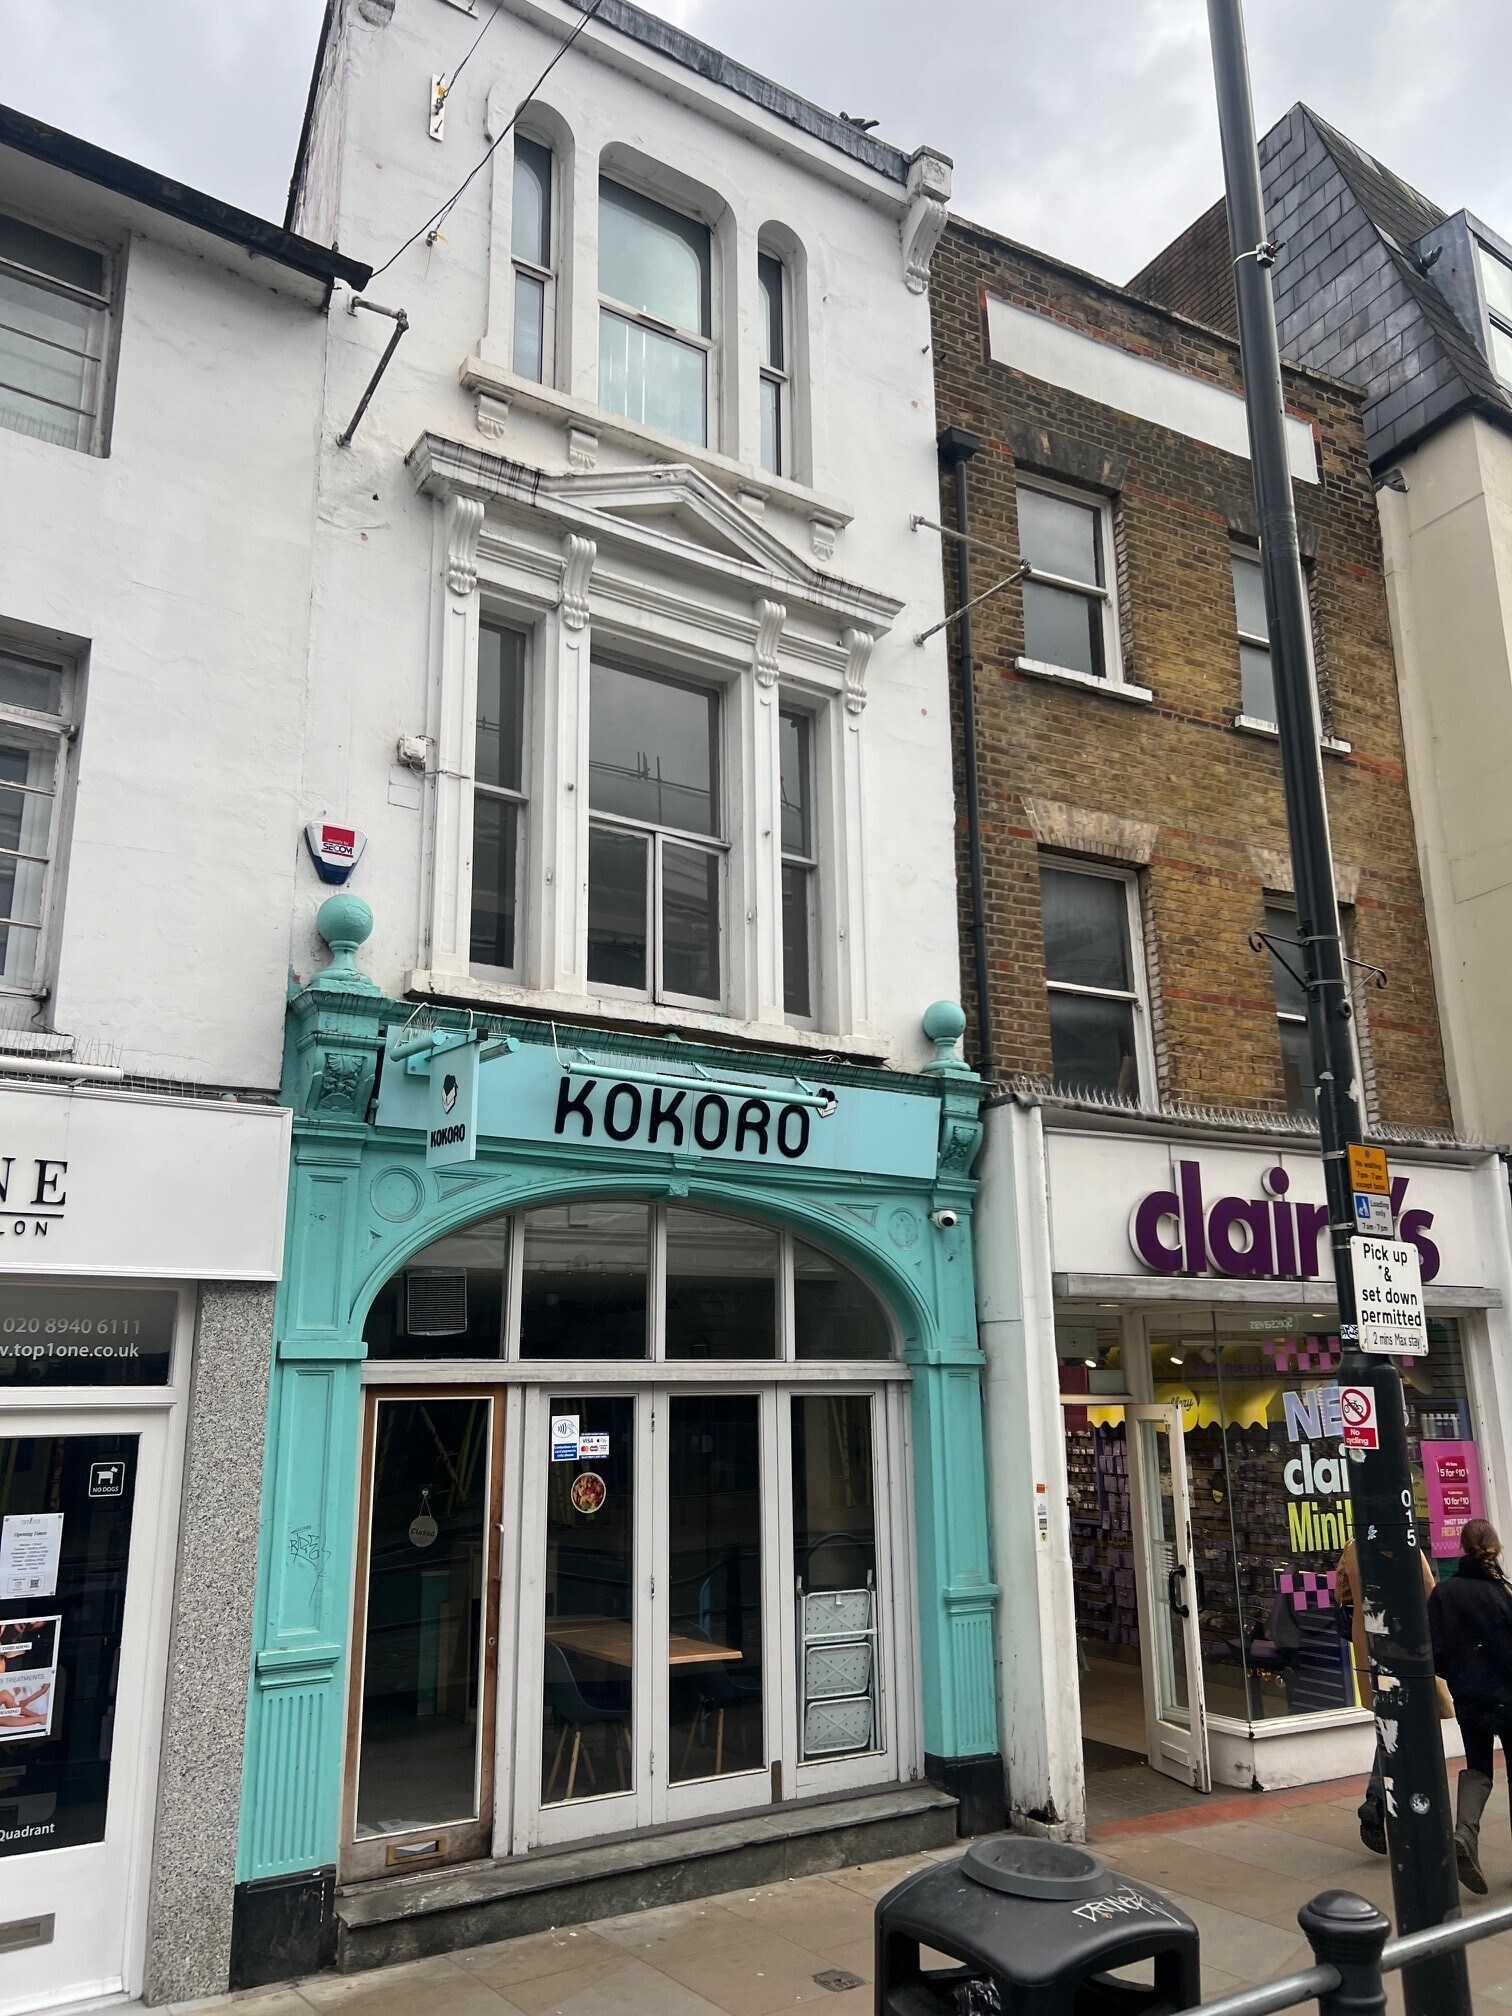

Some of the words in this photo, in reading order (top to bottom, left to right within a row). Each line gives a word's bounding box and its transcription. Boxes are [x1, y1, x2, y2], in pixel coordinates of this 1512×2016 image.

[323, 843, 353, 854] SECOM
[554, 1076, 810, 1158] KOKORO
[430, 1123, 466, 1148] KOKORO
[1364, 1163, 1382, 1171] waiting
[1356, 1182, 1372, 1190] except
[1371, 1201, 1389, 1210] Loading
[1130, 1160, 1440, 1283] clair's
[1375, 1210, 1386, 1218] only
[1363, 1243, 1389, 1262] Pick
[1393, 1250, 1408, 1266] up
[1384, 1266, 1392, 1282] &
[1362, 1286, 1381, 1303] set
[1385, 1287, 1418, 1306] down
[2, 1317, 40, 1333] 020
[44, 1318, 93, 1334] 8940
[97, 1319, 140, 1335] 6111
[1361, 1309, 1422, 1327] permitted
[1373, 1332, 1378, 1345] 2
[1379, 1333, 1393, 1346] mins
[1394, 1333, 1407, 1347] Max
[1408, 1334, 1420, 1349] stay
[1282, 1388, 1343, 1443] NE
[1350, 1428, 1360, 1436] No
[1346, 1437, 1369, 1446] cycling
[1440, 1469, 1445, 1477] 5
[1446, 1468, 1454, 1477] for
[1443, 1497, 1451, 1505] 10
[1451, 1497, 1460, 1505] for
[5, 1673, 45, 1683] TREATMENTS
[0, 1822, 55, 1841] Quadrant
